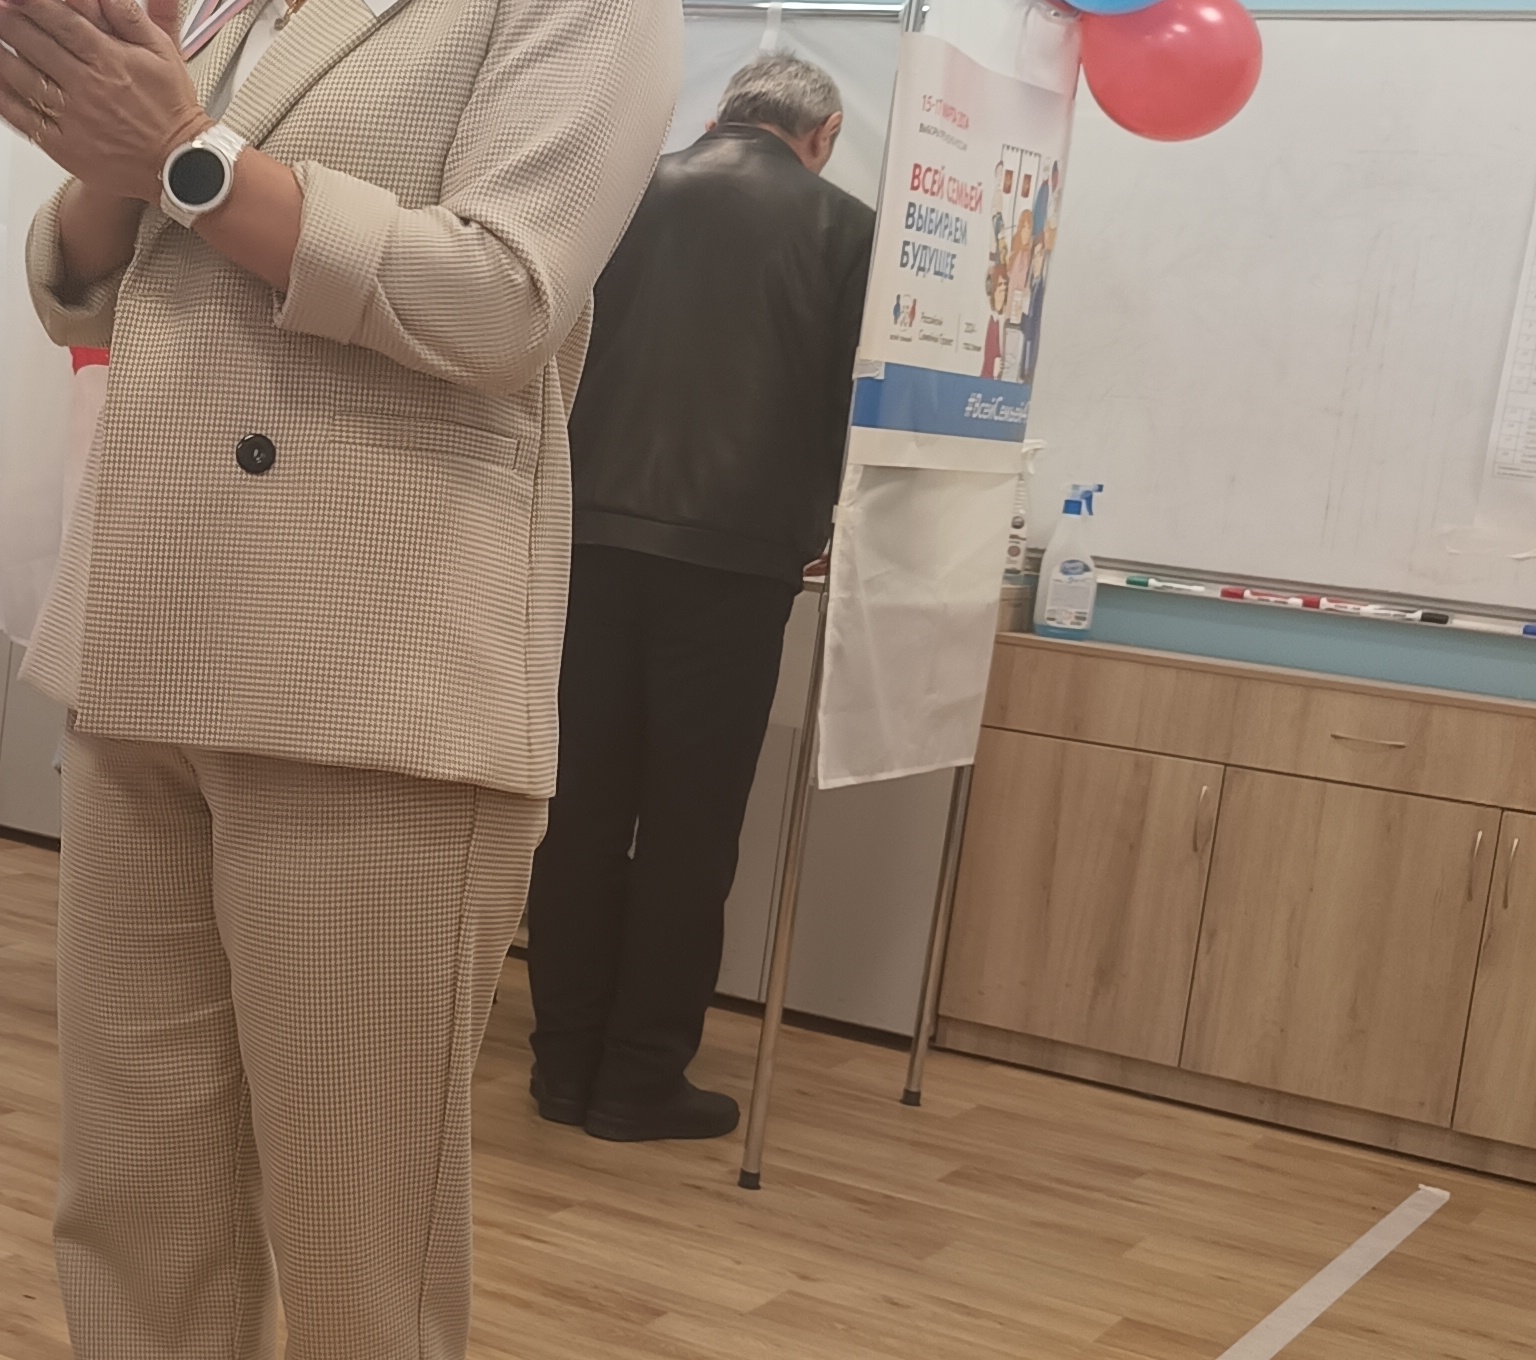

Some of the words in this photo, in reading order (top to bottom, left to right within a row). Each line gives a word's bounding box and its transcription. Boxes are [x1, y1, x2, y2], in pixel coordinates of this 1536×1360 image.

[910, 163, 946, 200] ВСЕЙ
[946, 175, 983, 214] СЕМЬЕЙ
[904, 201, 968, 246] ВЫБИРАЕМ
[899, 240, 957, 283] БУДУЩЕЕ
